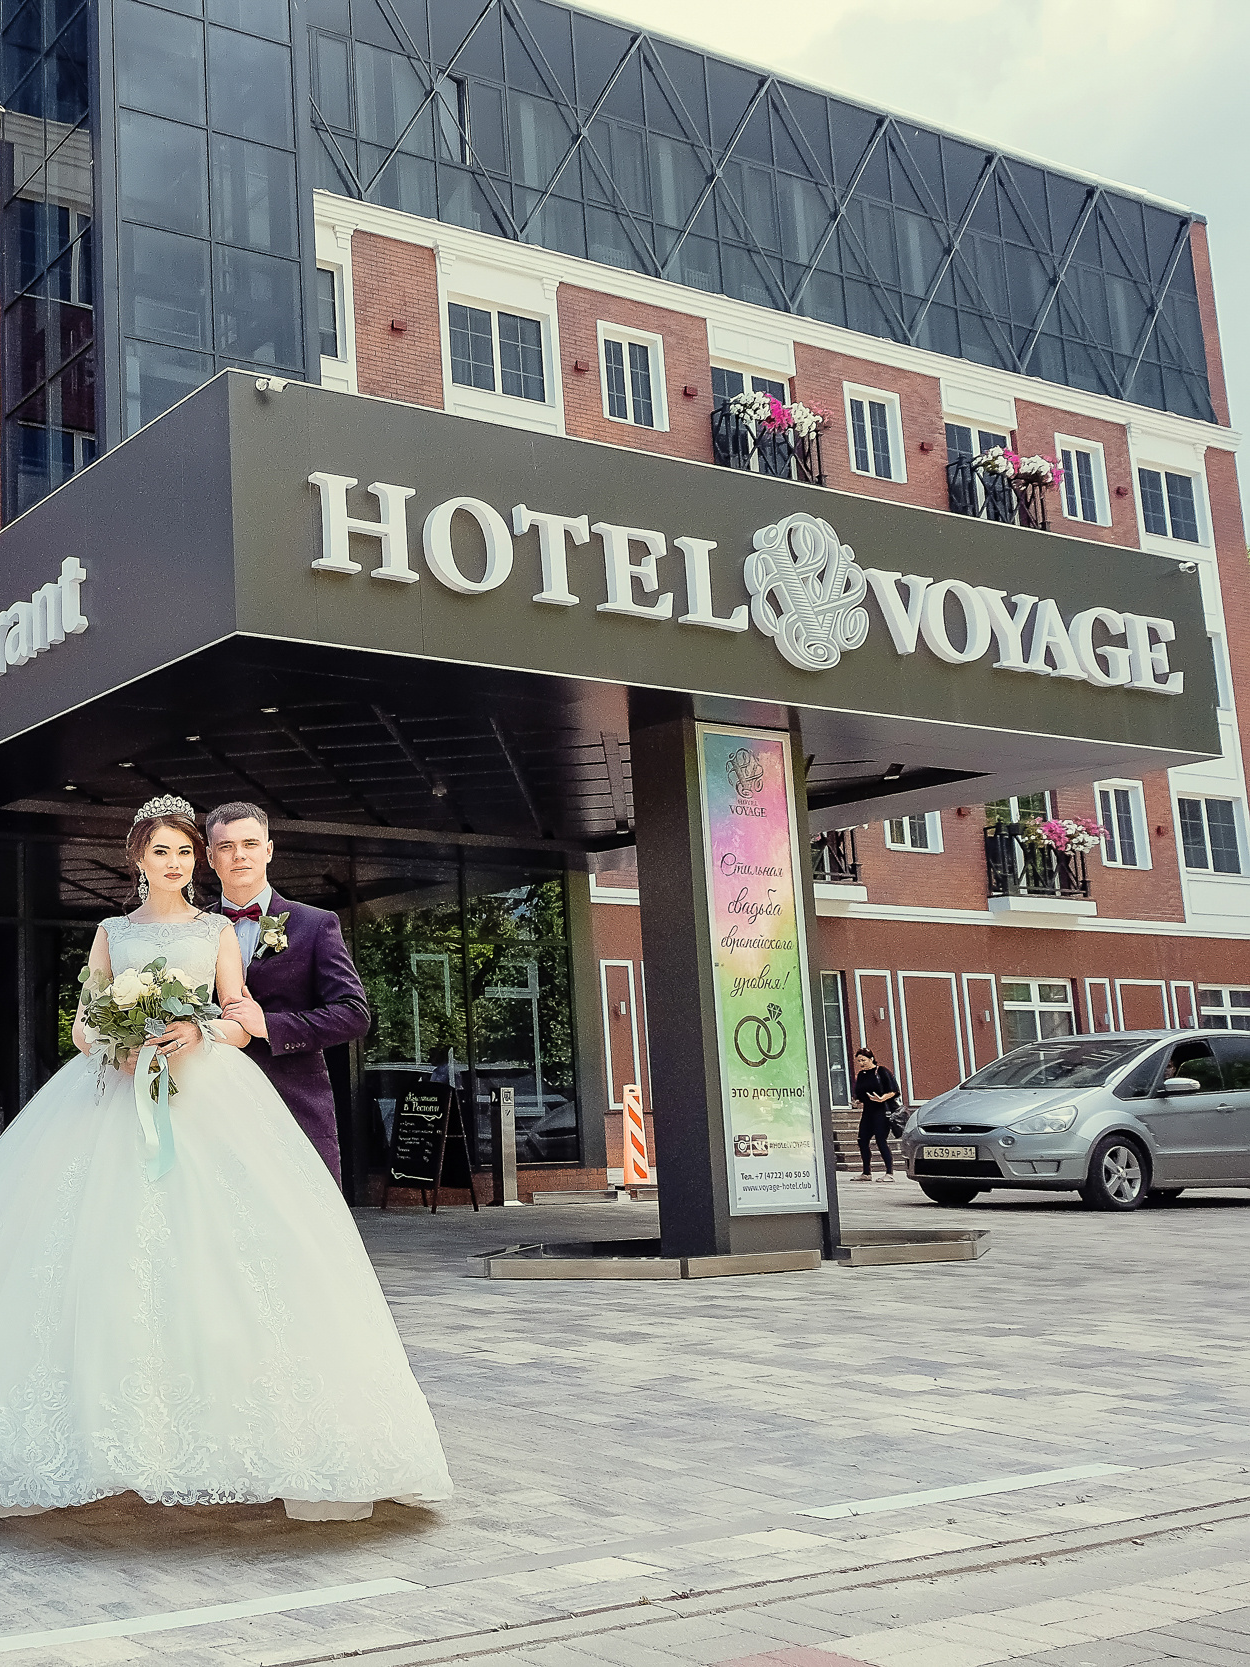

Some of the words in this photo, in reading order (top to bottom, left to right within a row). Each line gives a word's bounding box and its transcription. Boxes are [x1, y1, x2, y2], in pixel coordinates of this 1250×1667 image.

[308, 471, 748, 632] HOTEL
[864, 568, 1184, 695] VOYAGE
[728, 804, 767, 818] VOYAGE
[720, 852, 783, 877] Стильная
[727, 887, 782, 924] свадьба
[720, 925, 794, 954] европейского
[730, 964, 790, 997] уровня!
[742, 1182, 812, 1192] www.voyage-hotel.club
[764, 1171, 784, 1180] (4722)
[802, 1170, 810, 1178] 50
